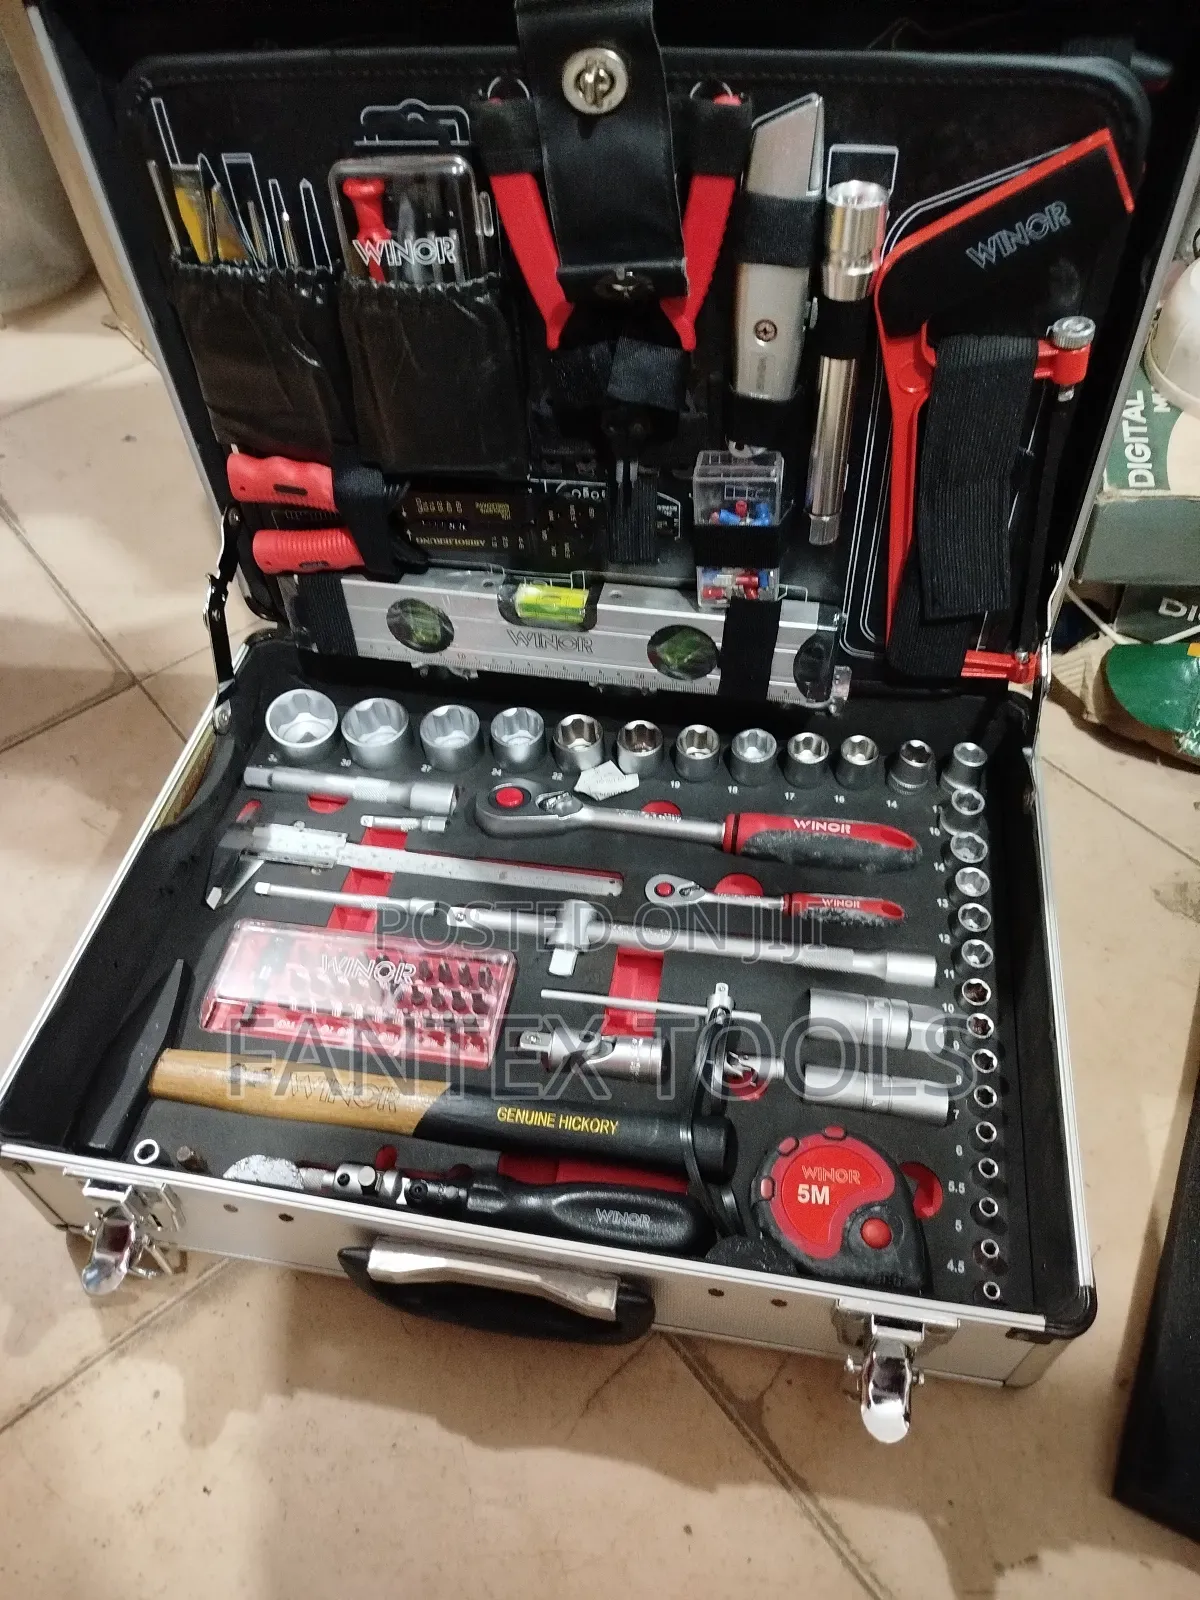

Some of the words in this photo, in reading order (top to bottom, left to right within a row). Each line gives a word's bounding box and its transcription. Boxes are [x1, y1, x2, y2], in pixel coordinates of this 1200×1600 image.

[965, 201, 1071, 269] WINOR
[352, 237, 456, 266] WINOR
[1122, 390, 1155, 487] DIGITAL
[1158, 597, 1200, 622] DI
[507, 629, 594, 653] WINOR
[785, 791, 796, 801] 17
[886, 799, 898, 809] 14
[793, 818, 851, 834] WINOR
[822, 897, 861, 910] WINOR
[936, 897, 949, 909] 13
[938, 933, 951, 945] 12
[321, 954, 417, 985] WINOR
[943, 968, 955, 980] 11
[941, 1002, 955, 1014] 10
[289, 1072, 399, 1113] WINOR
[497, 1106, 556, 1129] GENUINE
[559, 1113, 619, 1136] HICKORY
[952, 1108, 960, 1120] 7
[802, 1165, 861, 1185] WINOR
[797, 1183, 830, 1206] 5M
[948, 1180, 966, 1195] 5.5
[596, 1207, 651, 1230] WINOR
[946, 1258, 965, 1275] 4.5
